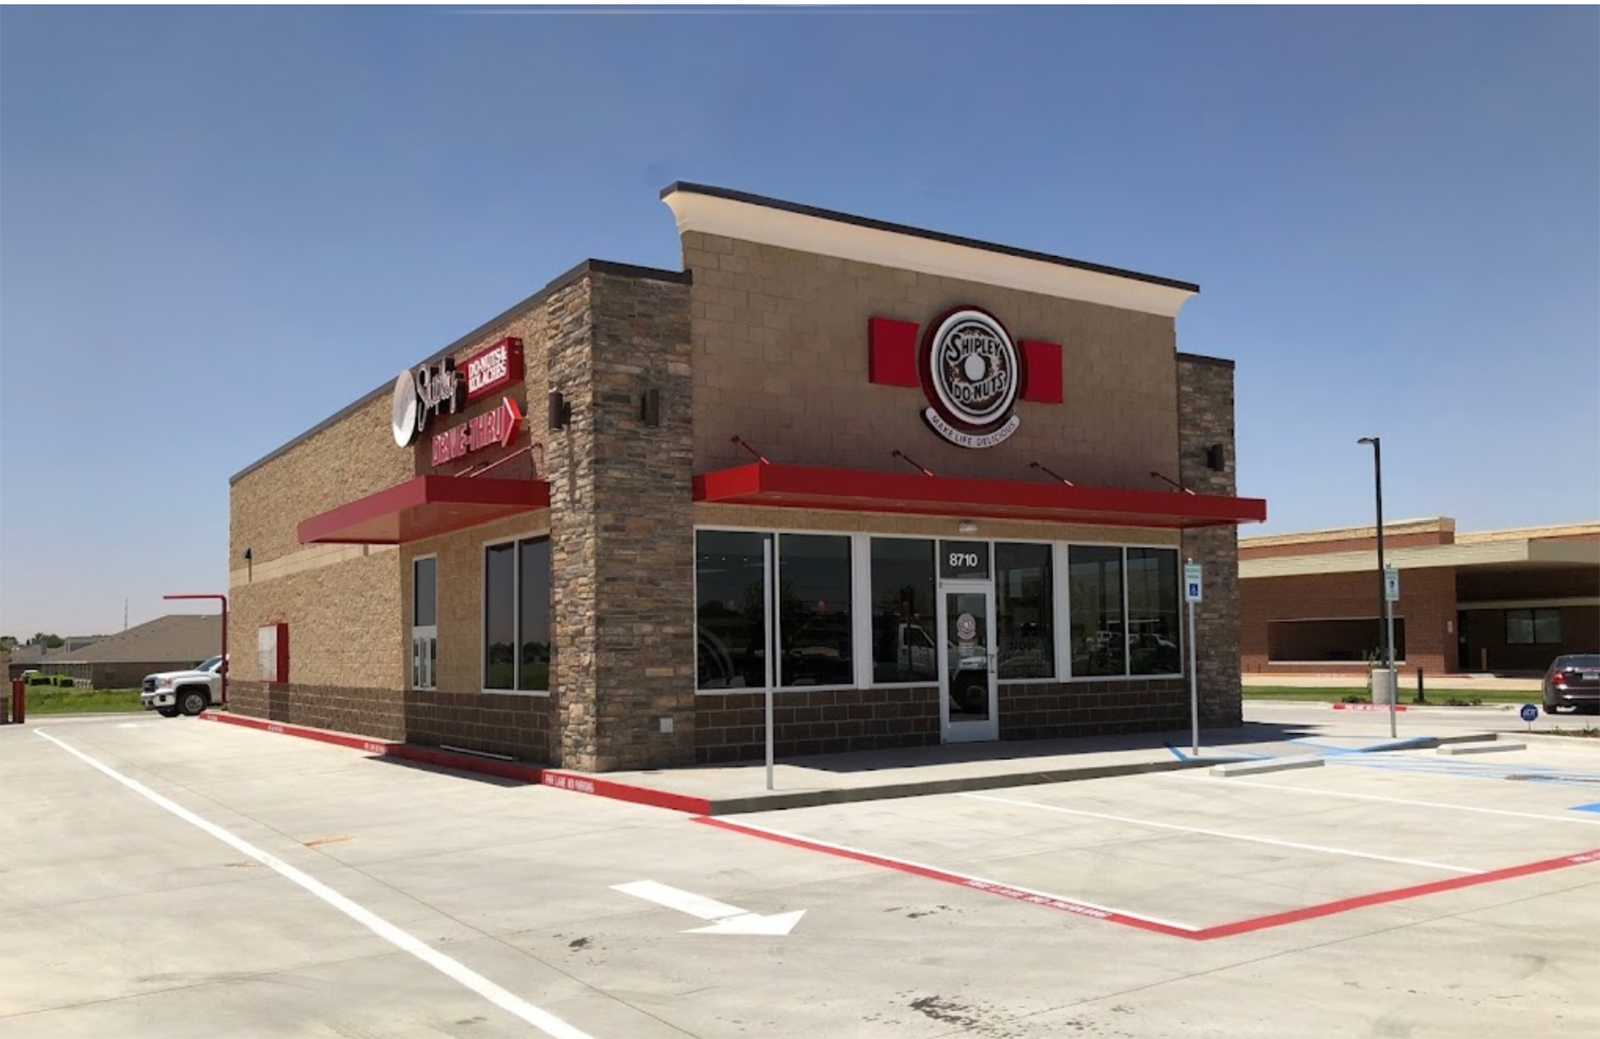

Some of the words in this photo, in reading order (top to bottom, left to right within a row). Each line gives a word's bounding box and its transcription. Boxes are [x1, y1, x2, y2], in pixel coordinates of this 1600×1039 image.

[946, 333, 1001, 362] SHIPLEY
[432, 406, 506, 466] DRIVE-THRU
[931, 415, 954, 438] MAKE
[955, 434, 973, 447] LIFE
[976, 420, 1017, 447] DELICIOUS
[949, 552, 978, 567] 8710
